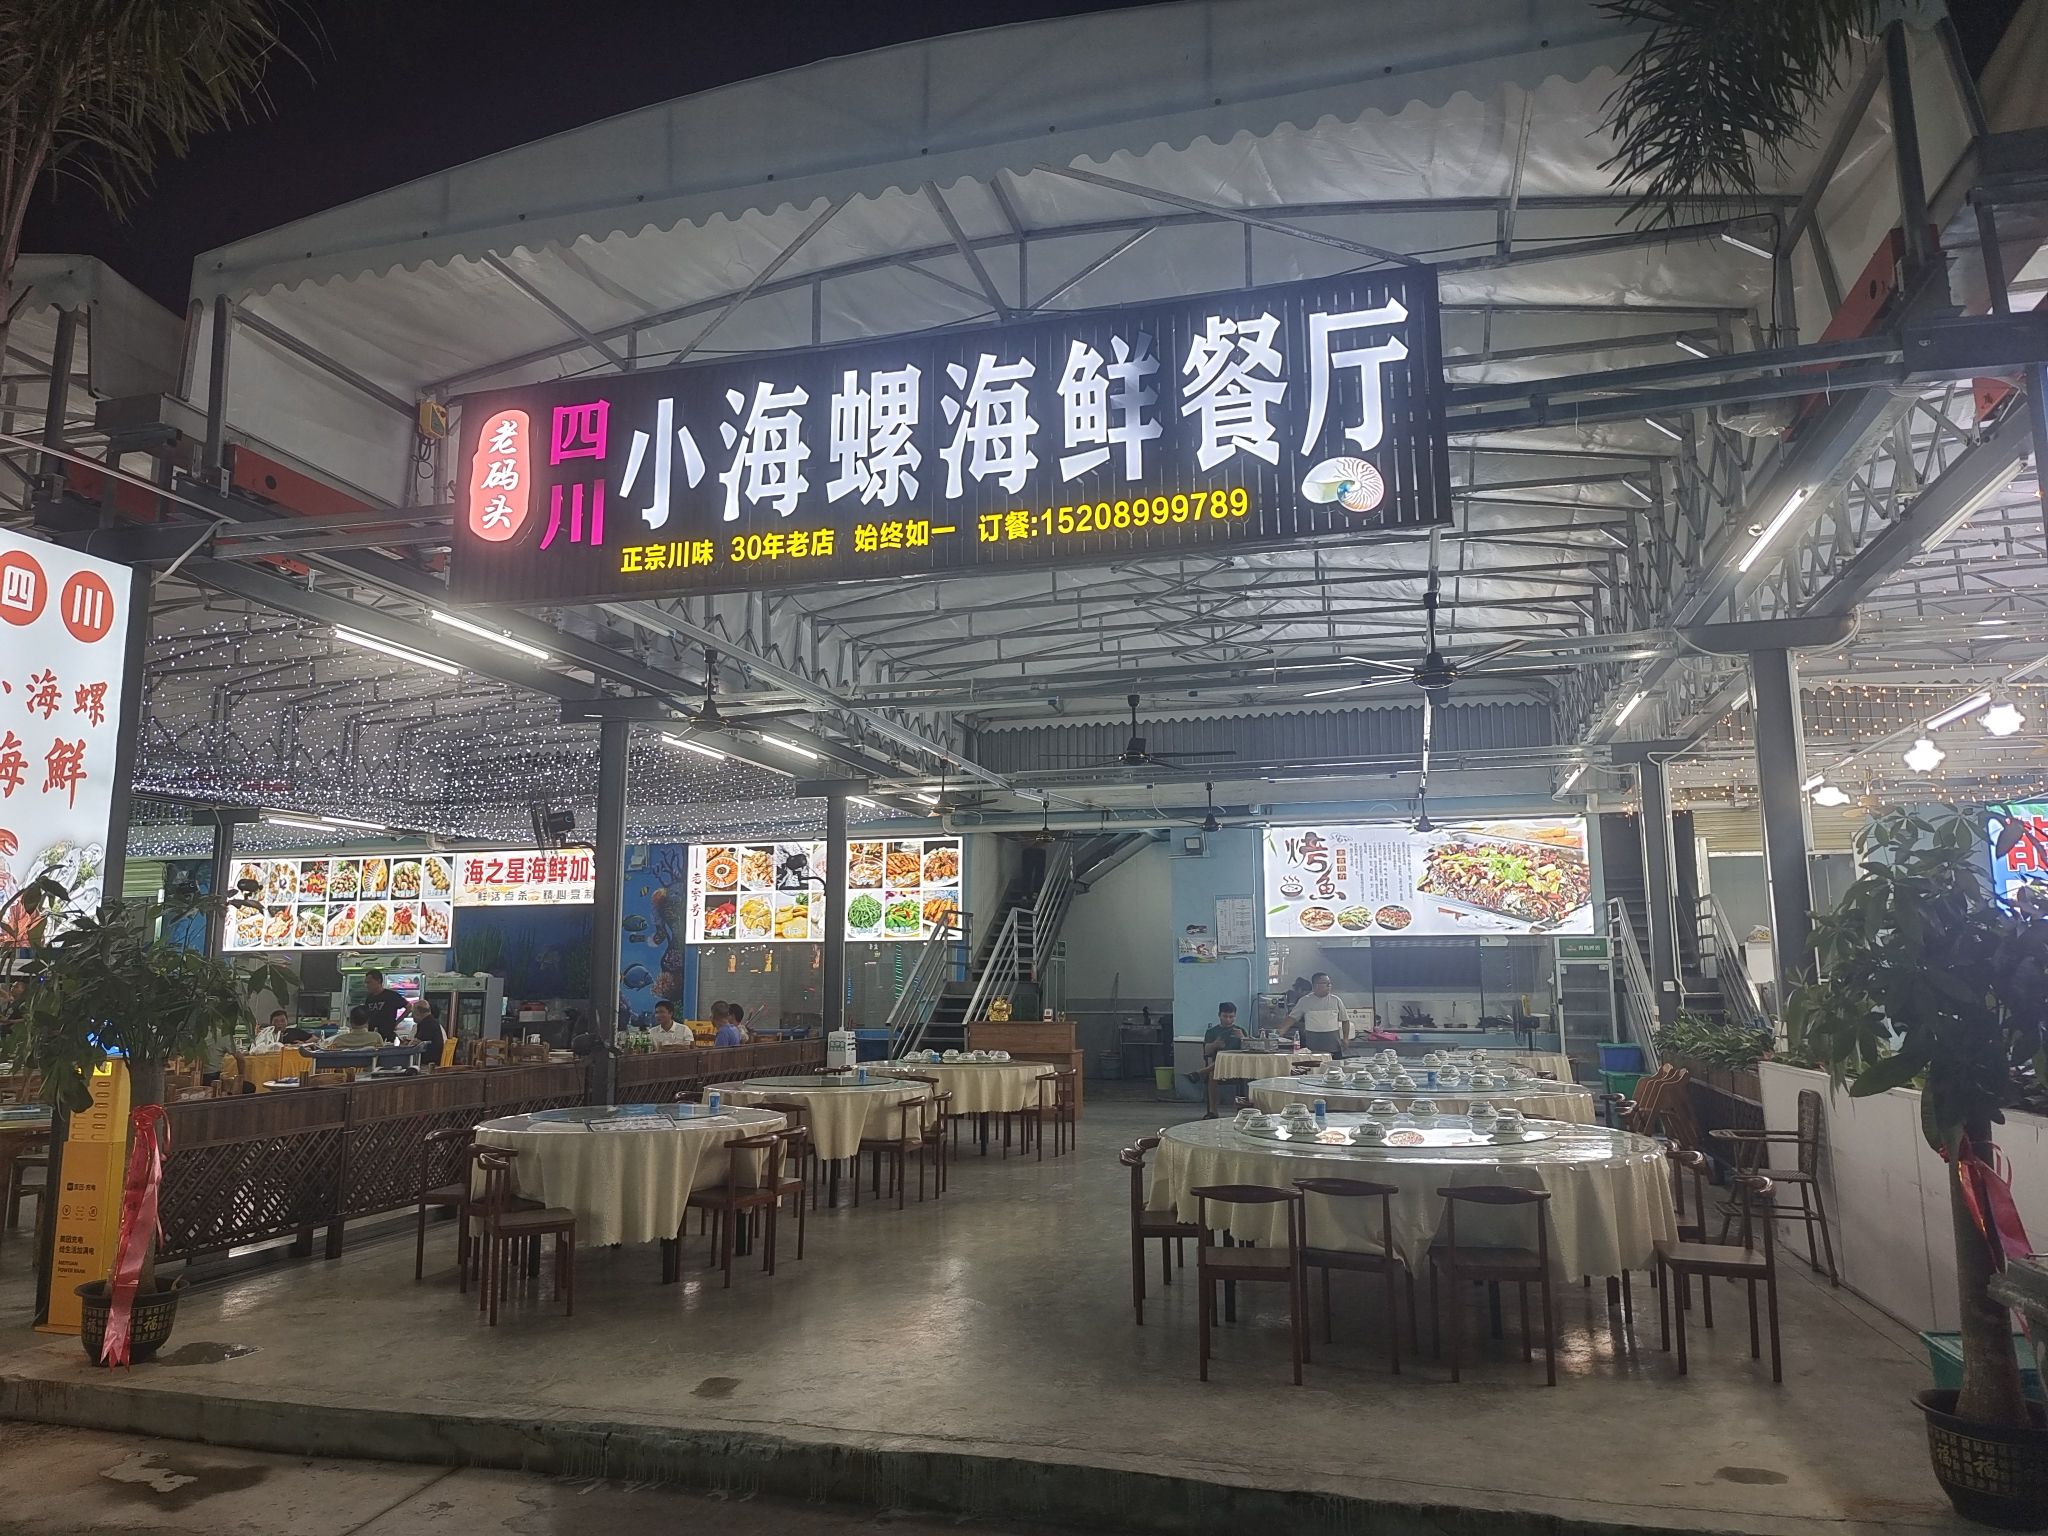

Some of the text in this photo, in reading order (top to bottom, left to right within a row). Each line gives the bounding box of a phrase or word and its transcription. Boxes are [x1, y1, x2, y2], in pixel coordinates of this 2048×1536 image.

[618, 297, 1409, 531] 小海螺海鲜餐厅
[480, 419, 520, 531] 老码头
[539, 399, 611, 550] 四川
[620, 487, 1249, 573] 正宗川味 30年老店 始终如一 订餐:15208999789
[2, 565, 104, 631] 四川
[2, 668, 108, 728] 海螺
[464, 856, 596, 885] 海之星海鲜加
[1285, 831, 1347, 901] 烤鱼
